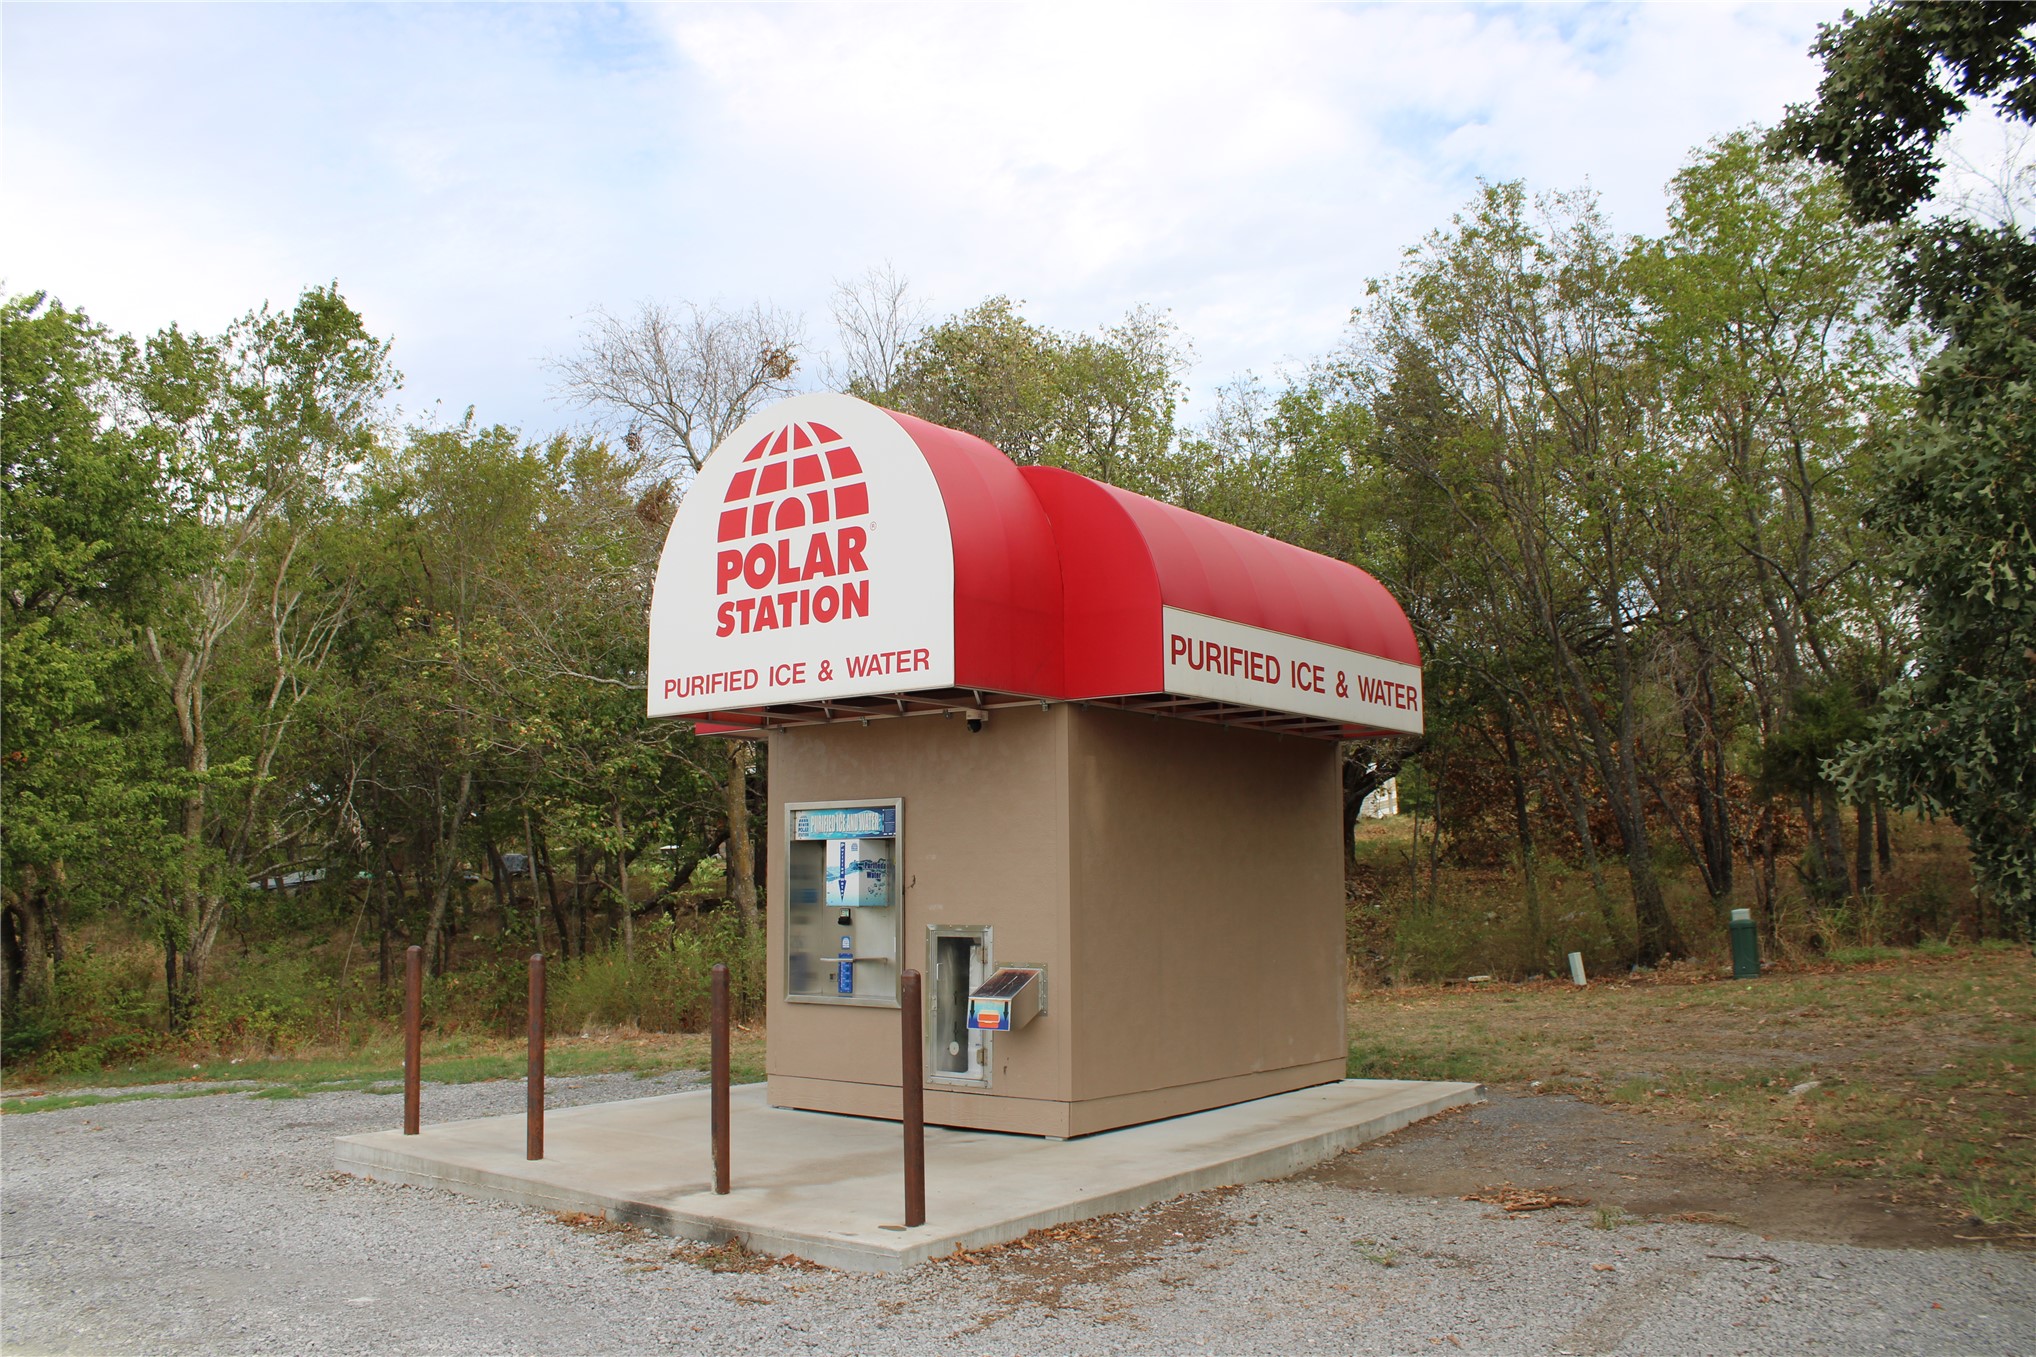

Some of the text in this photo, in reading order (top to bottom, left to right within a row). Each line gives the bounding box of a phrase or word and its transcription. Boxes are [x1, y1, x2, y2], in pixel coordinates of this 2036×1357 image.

[716, 526, 869, 595] POLAR
[716, 579, 869, 638] STATION
[664, 647, 930, 700] PURIFIED ICE & WATER
[1171, 634, 1418, 711] PURIFIED ICE & WATER
[810, 814, 836, 833] PURIFIED
[836, 813, 846, 832] ICE
[847, 813, 858, 832] AND
[858, 812, 879, 831] WATER
